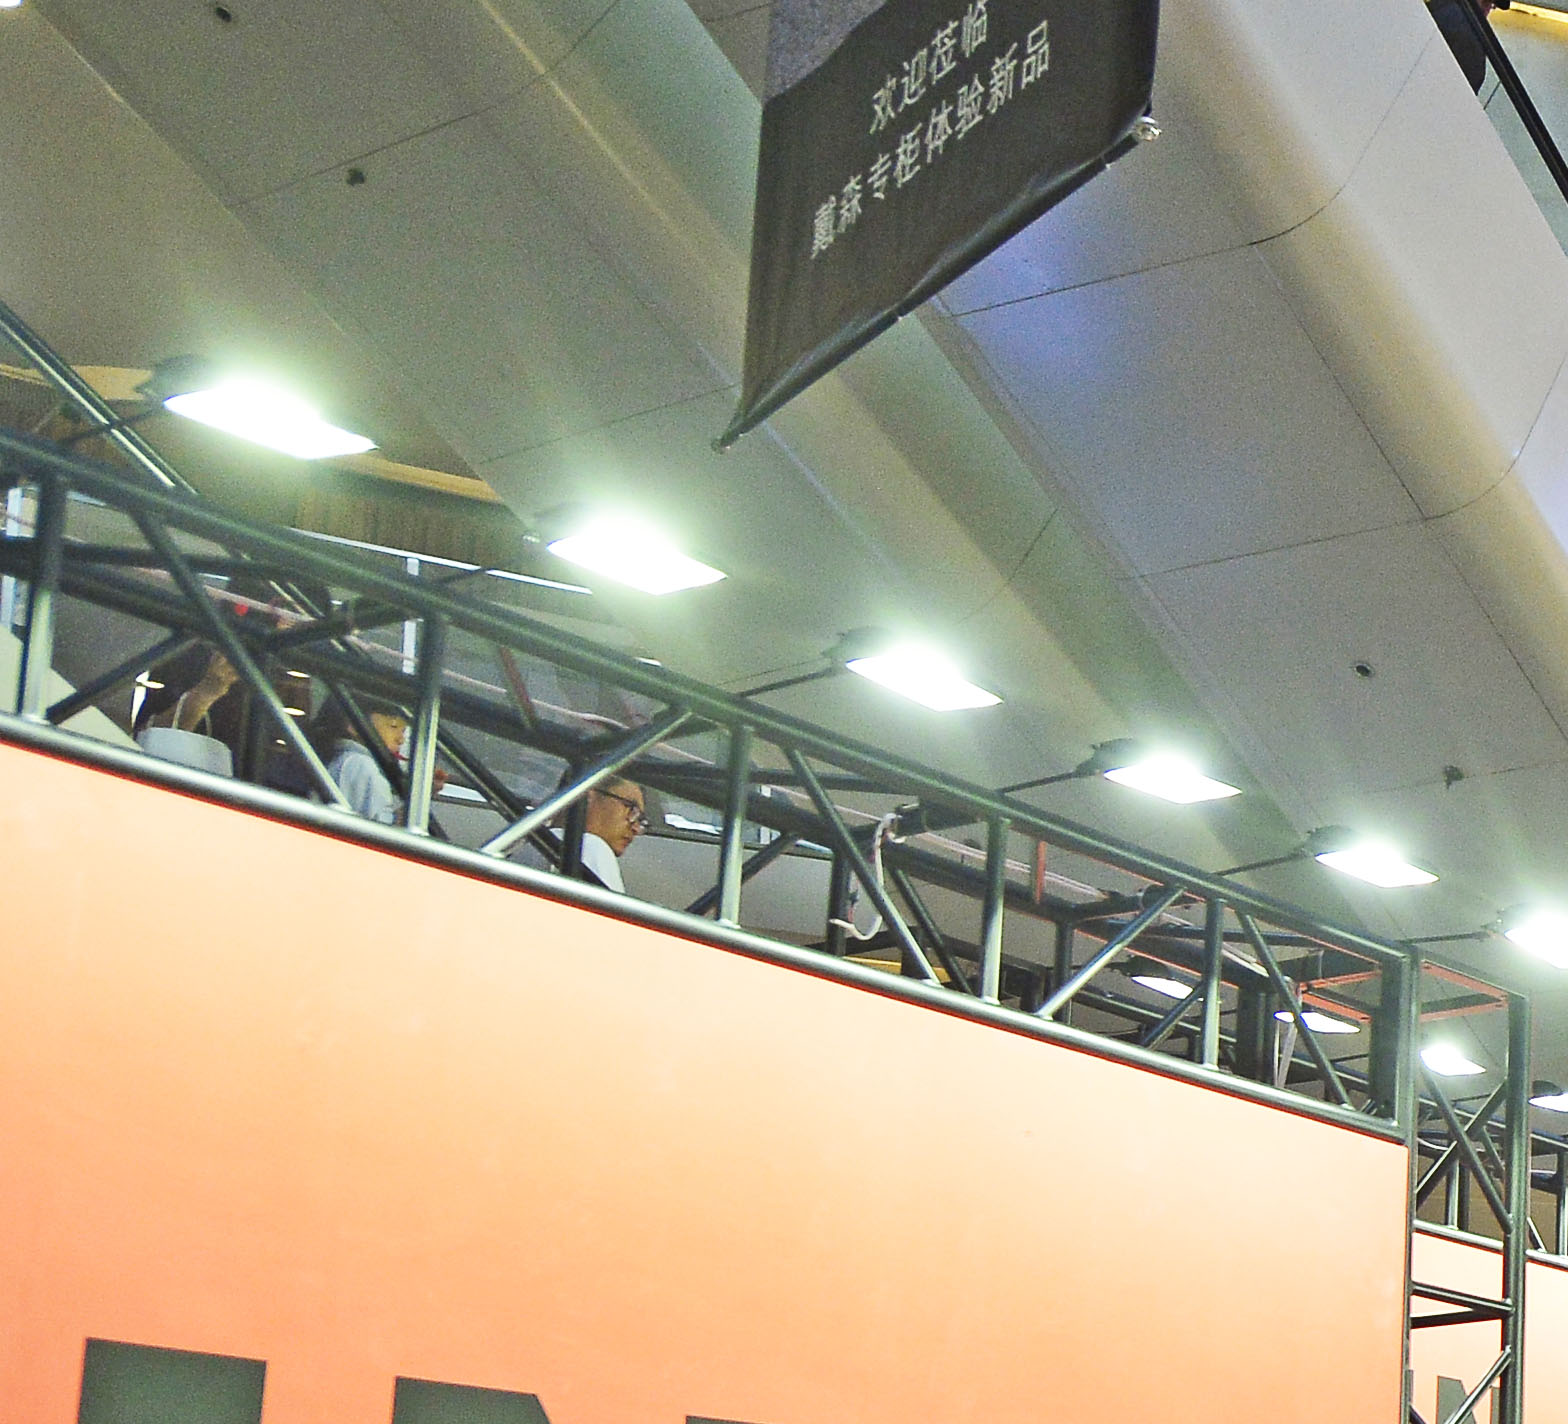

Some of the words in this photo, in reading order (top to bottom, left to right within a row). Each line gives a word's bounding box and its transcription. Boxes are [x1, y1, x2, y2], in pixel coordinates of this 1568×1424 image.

[810, 20, 1051, 259] 戴森专柜体验新品
[870, 0, 989, 134] 欢迎莅临
